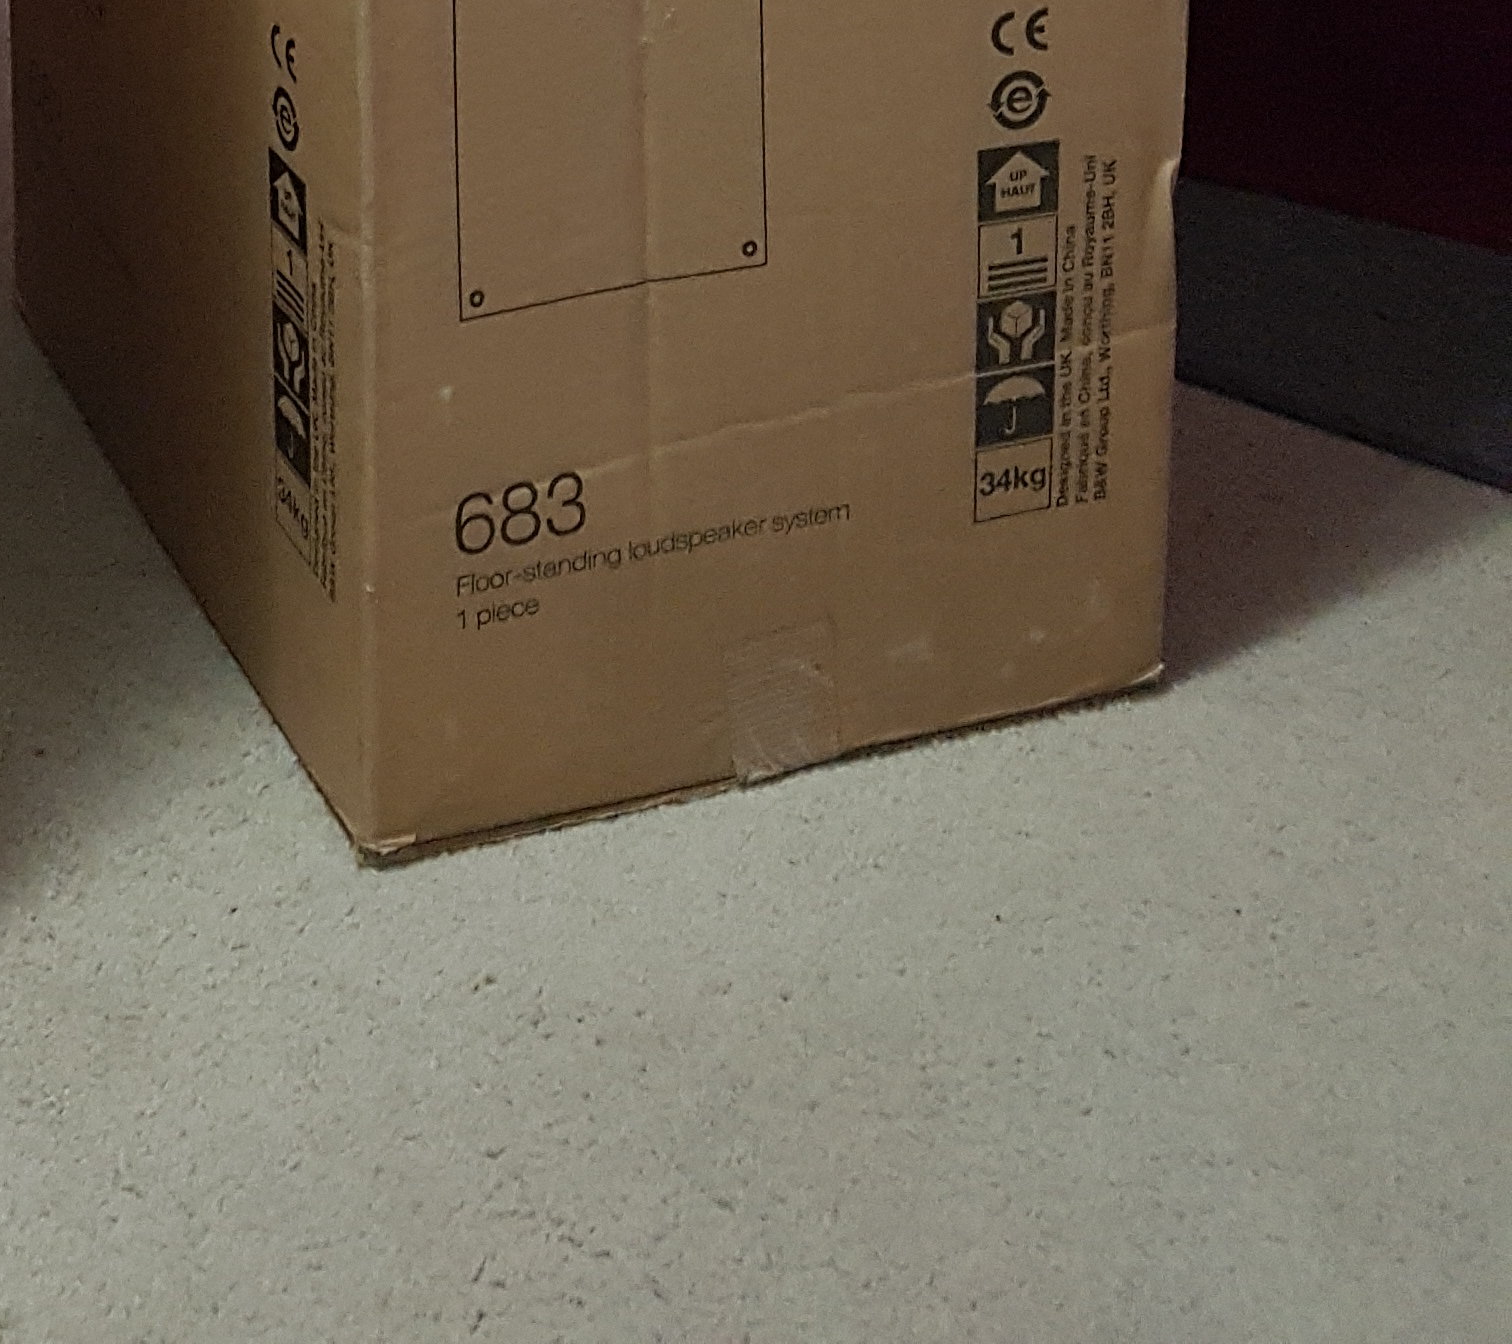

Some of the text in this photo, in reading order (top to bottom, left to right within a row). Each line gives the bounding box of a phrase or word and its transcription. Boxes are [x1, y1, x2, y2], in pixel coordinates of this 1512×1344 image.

[1008, 169, 1028, 183] UP
[1102, 160, 1117, 186] UK
[1000, 183, 1038, 199] HAUT
[1009, 227, 1026, 255] 1
[979, 464, 1046, 496] 34kg
[455, 471, 587, 556] 683
[456, 502, 851, 597] Floor-standing loudspeaker system
[457, 595, 541, 631] 1 piece
